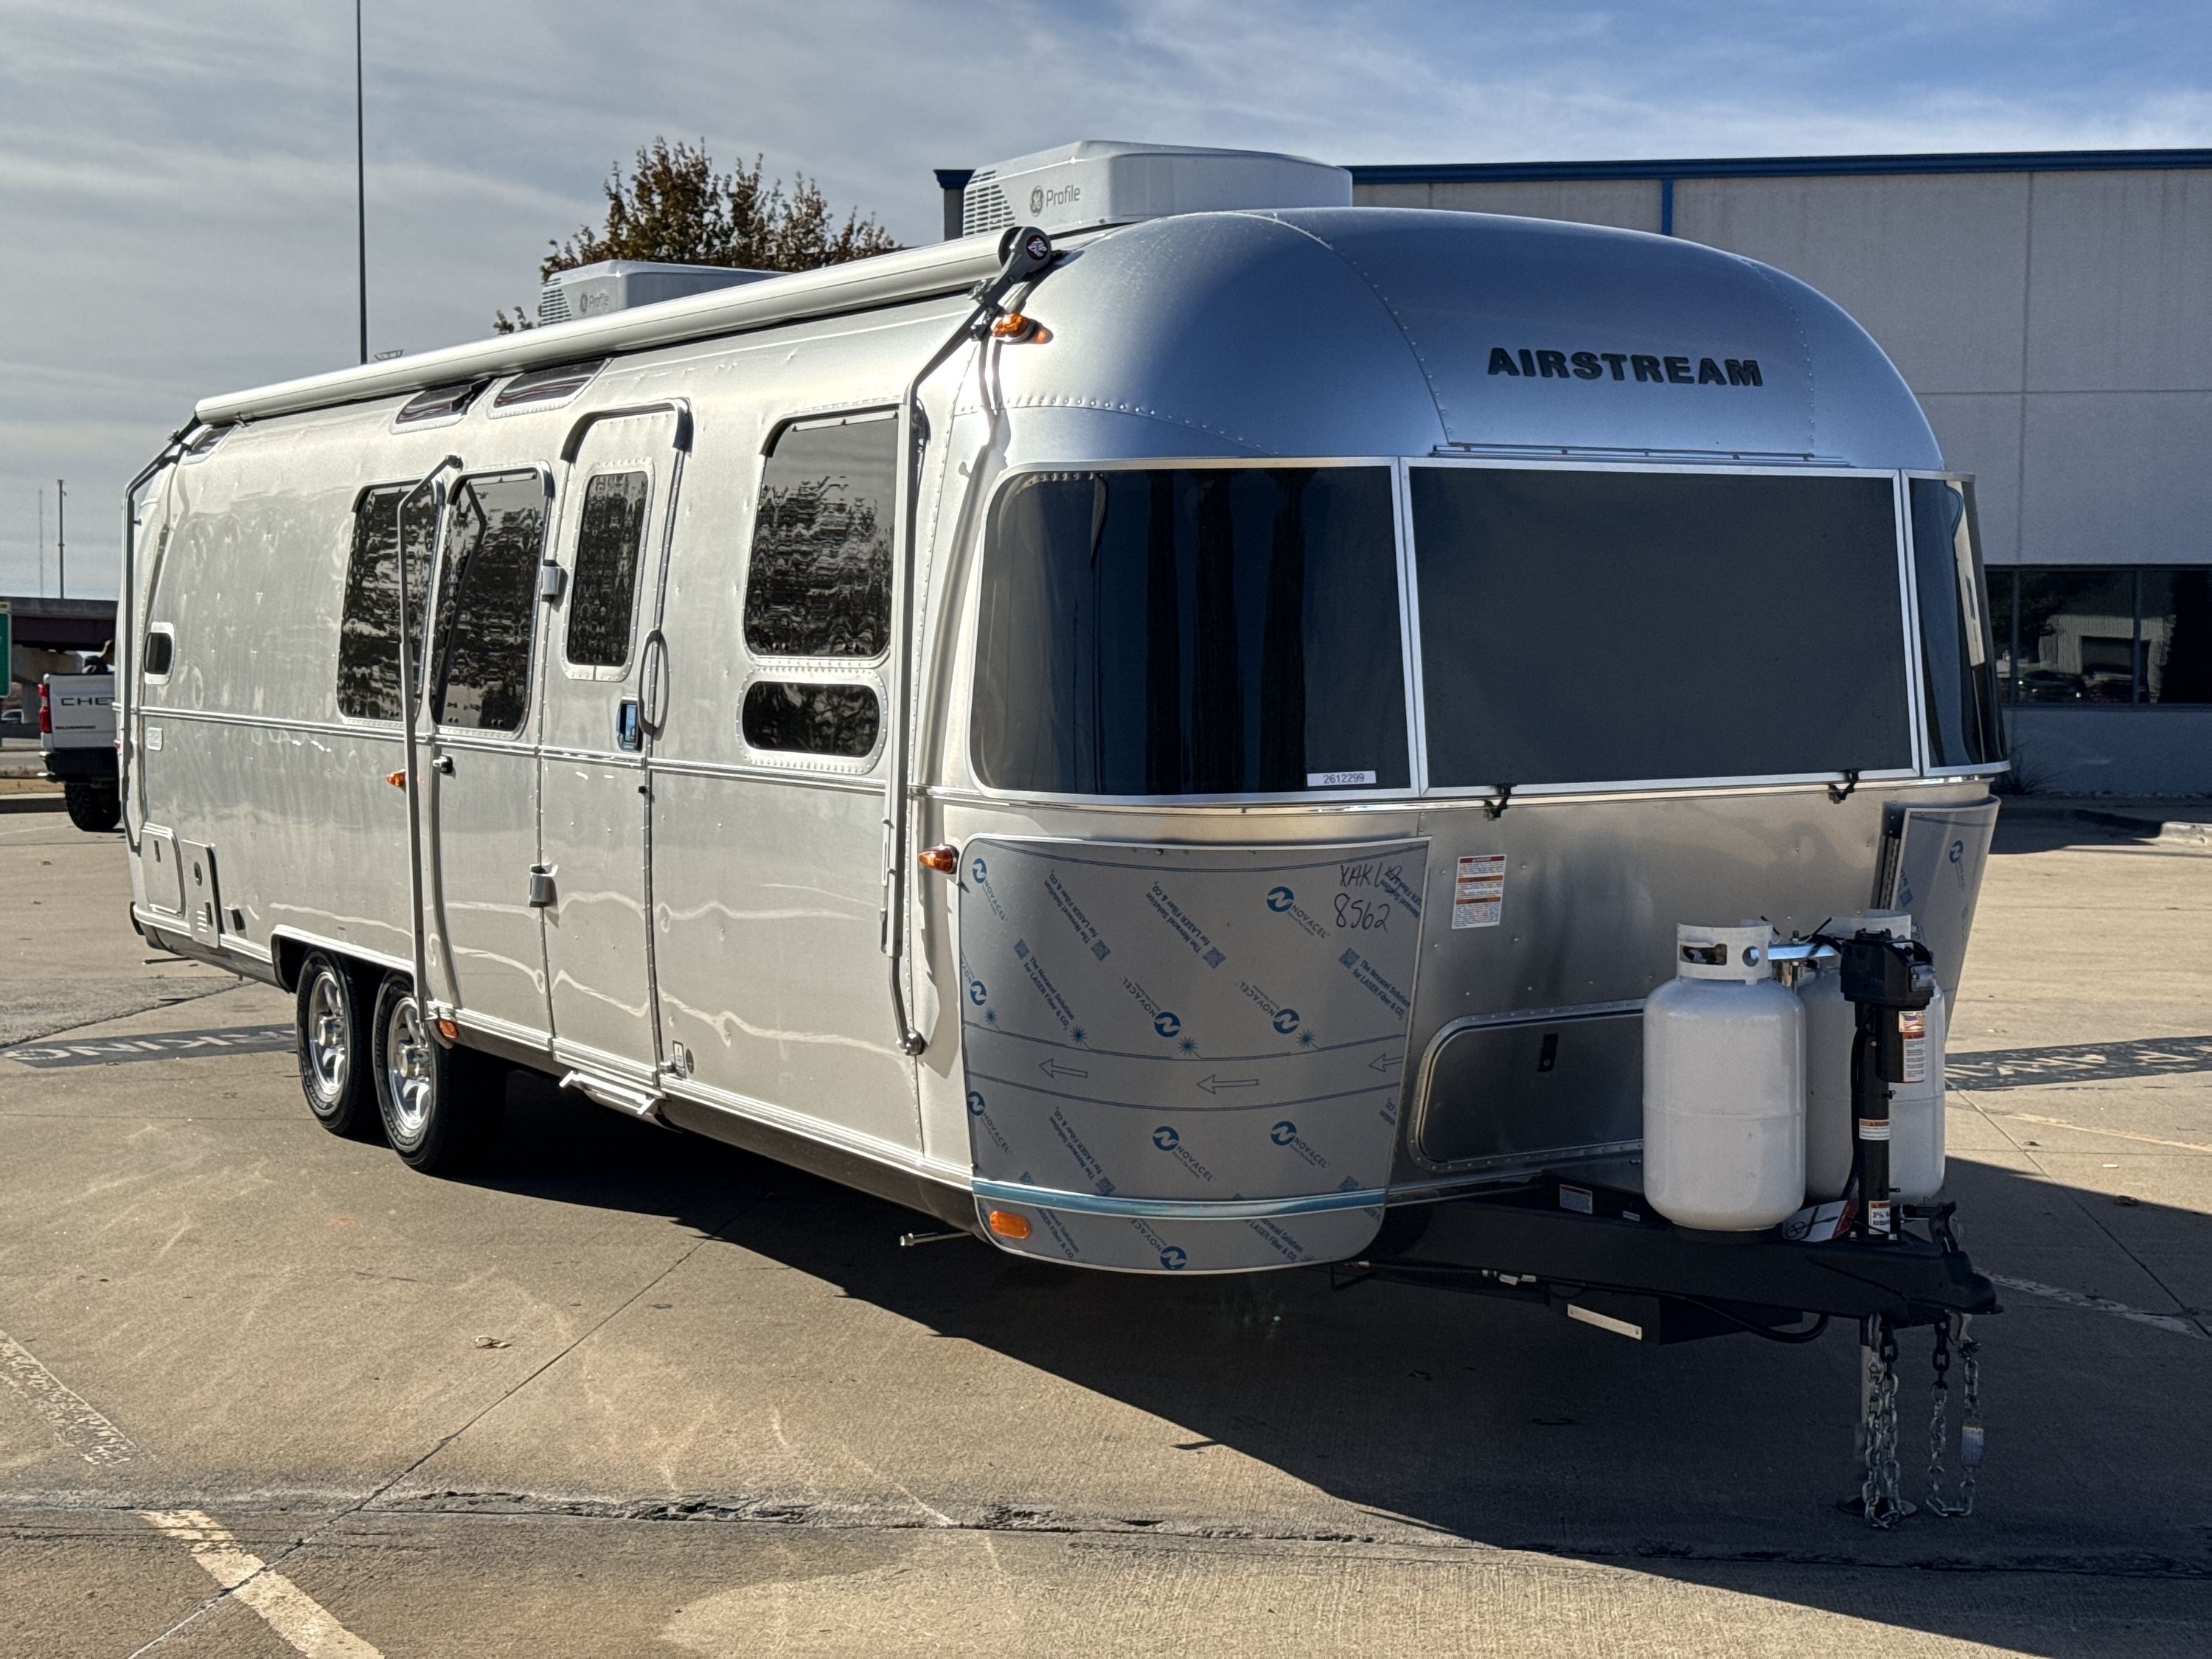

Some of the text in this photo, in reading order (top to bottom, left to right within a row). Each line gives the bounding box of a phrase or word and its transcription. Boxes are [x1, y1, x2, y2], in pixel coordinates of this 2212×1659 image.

[1046, 184, 1080, 207] Profile
[1487, 347, 1763, 386] AIRSTREAM
[1324, 773, 1365, 784] 2612299
[984, 880, 1006, 922] NOVACEL
[1072, 905, 1090, 928] LASER
[1334, 893, 1390, 932] 8562
[1180, 915, 1201, 936] LASER
[1291, 905, 1326, 939] NOVACEL
[1030, 973, 1046, 995] LASER
[1123, 977, 1157, 1017] NOVACEL
[1239, 981, 1276, 1017] NOVACEL
[1360, 975, 1379, 995] LASER
[983, 1113, 1009, 1154] NOVACEL
[1176, 1145, 1213, 1181] NOVACEL
[1293, 1136, 1326, 1168] NOVACEL
[1128, 1217, 1164, 1252] NOVACE
